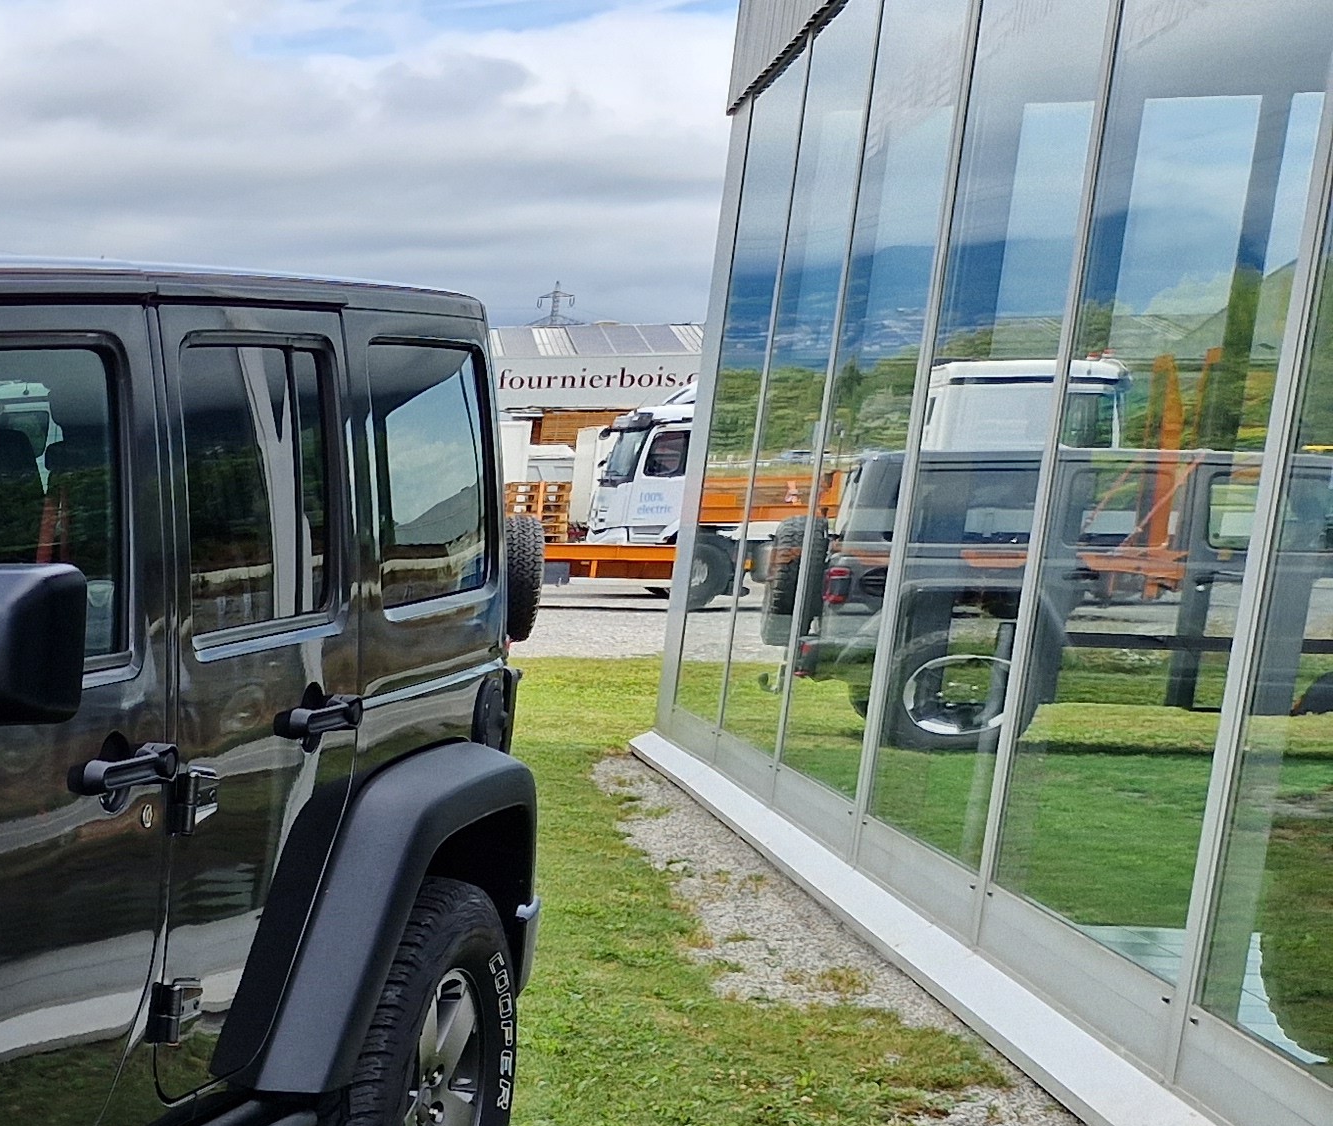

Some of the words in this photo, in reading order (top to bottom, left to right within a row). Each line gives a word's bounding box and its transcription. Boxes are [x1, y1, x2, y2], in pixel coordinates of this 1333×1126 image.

[639, 492, 664, 503] 100%
[637, 504, 673, 515] electric
[488, 951, 517, 1110] COOPER
